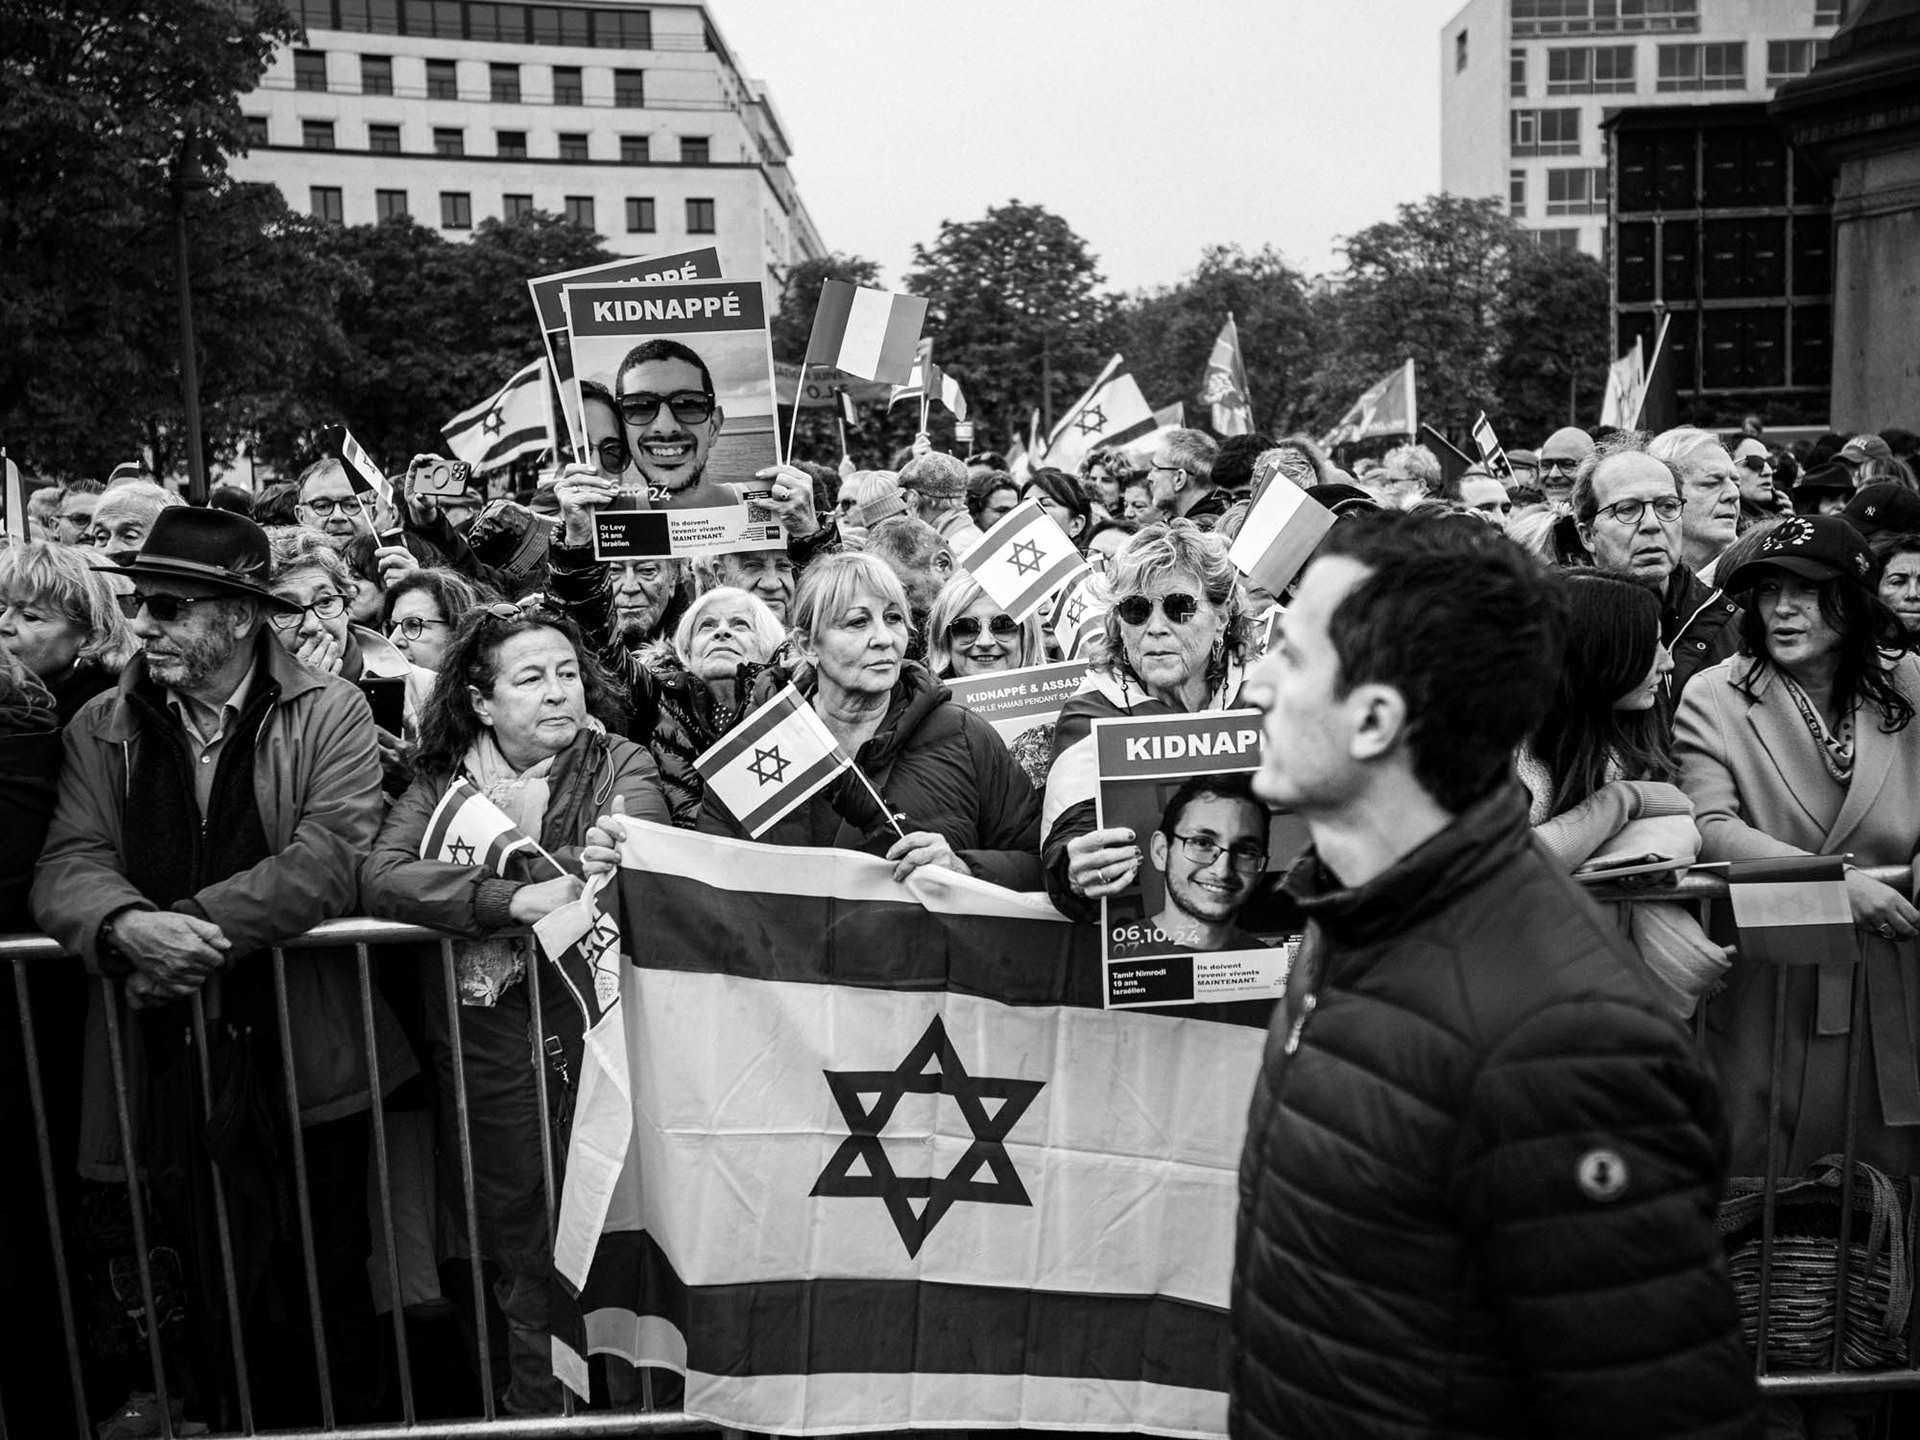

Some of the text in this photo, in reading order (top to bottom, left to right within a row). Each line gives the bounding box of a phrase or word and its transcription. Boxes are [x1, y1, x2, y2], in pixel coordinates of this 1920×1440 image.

[593, 291, 741, 322] KIDNAPPÉ
[609, 524, 626, 533] Levy
[699, 525, 726, 533] vivants
[672, 532, 724, 542] MAINTENANT.
[966, 676, 1086, 704] KIDNAPPÉ & ASSASS
[970, 704, 986, 714] PAR
[987, 703, 996, 711] LE
[997, 699, 1024, 710] HAMAS
[1024, 694, 1058, 706] PENDANT
[1059, 692, 1069, 700] SA
[1126, 729, 1263, 761] KIDNAP
[1112, 968, 1167, 980] Tamir Nimrodi
[1229, 969, 1260, 977] vivants
[1197, 978, 1258, 986] MAINTENANT.
[1113, 987, 1146, 996] Israélien
